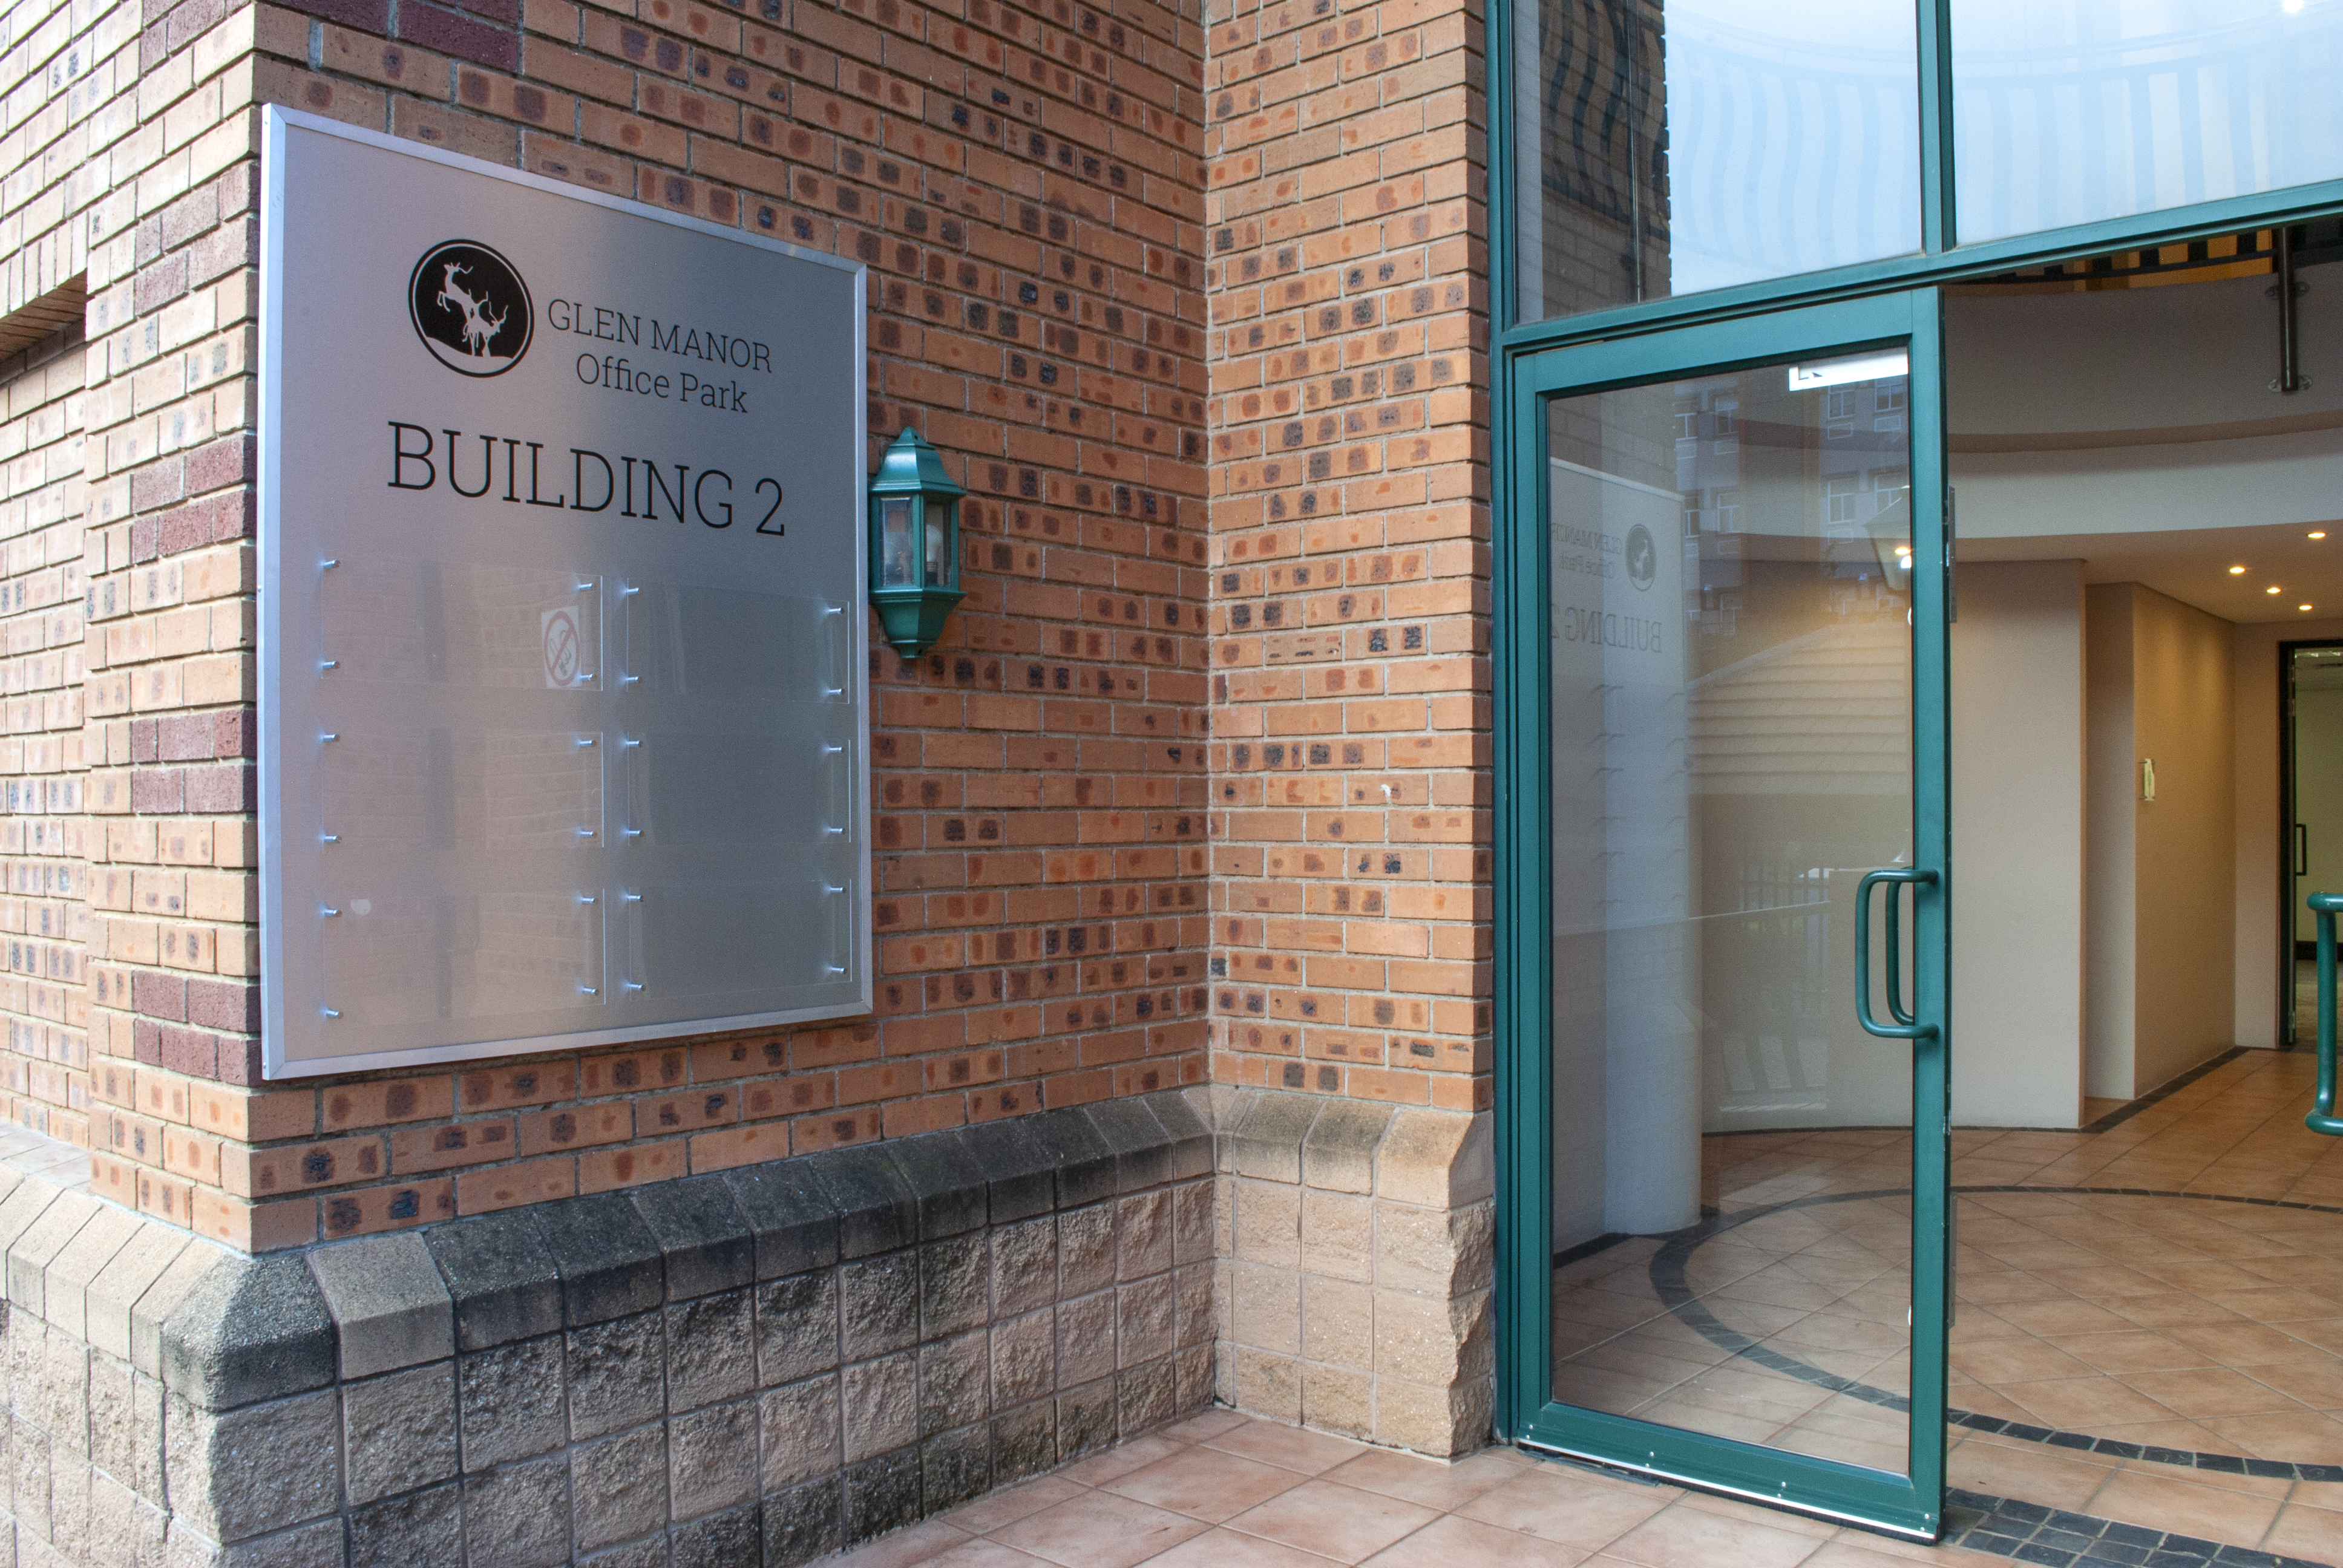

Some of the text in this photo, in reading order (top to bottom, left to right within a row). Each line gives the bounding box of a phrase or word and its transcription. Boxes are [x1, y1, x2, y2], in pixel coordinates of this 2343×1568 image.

[548, 298, 773, 374] GLEN MANOR
[575, 352, 749, 414] Office Park
[387, 420, 785, 537] BUILDING 2
